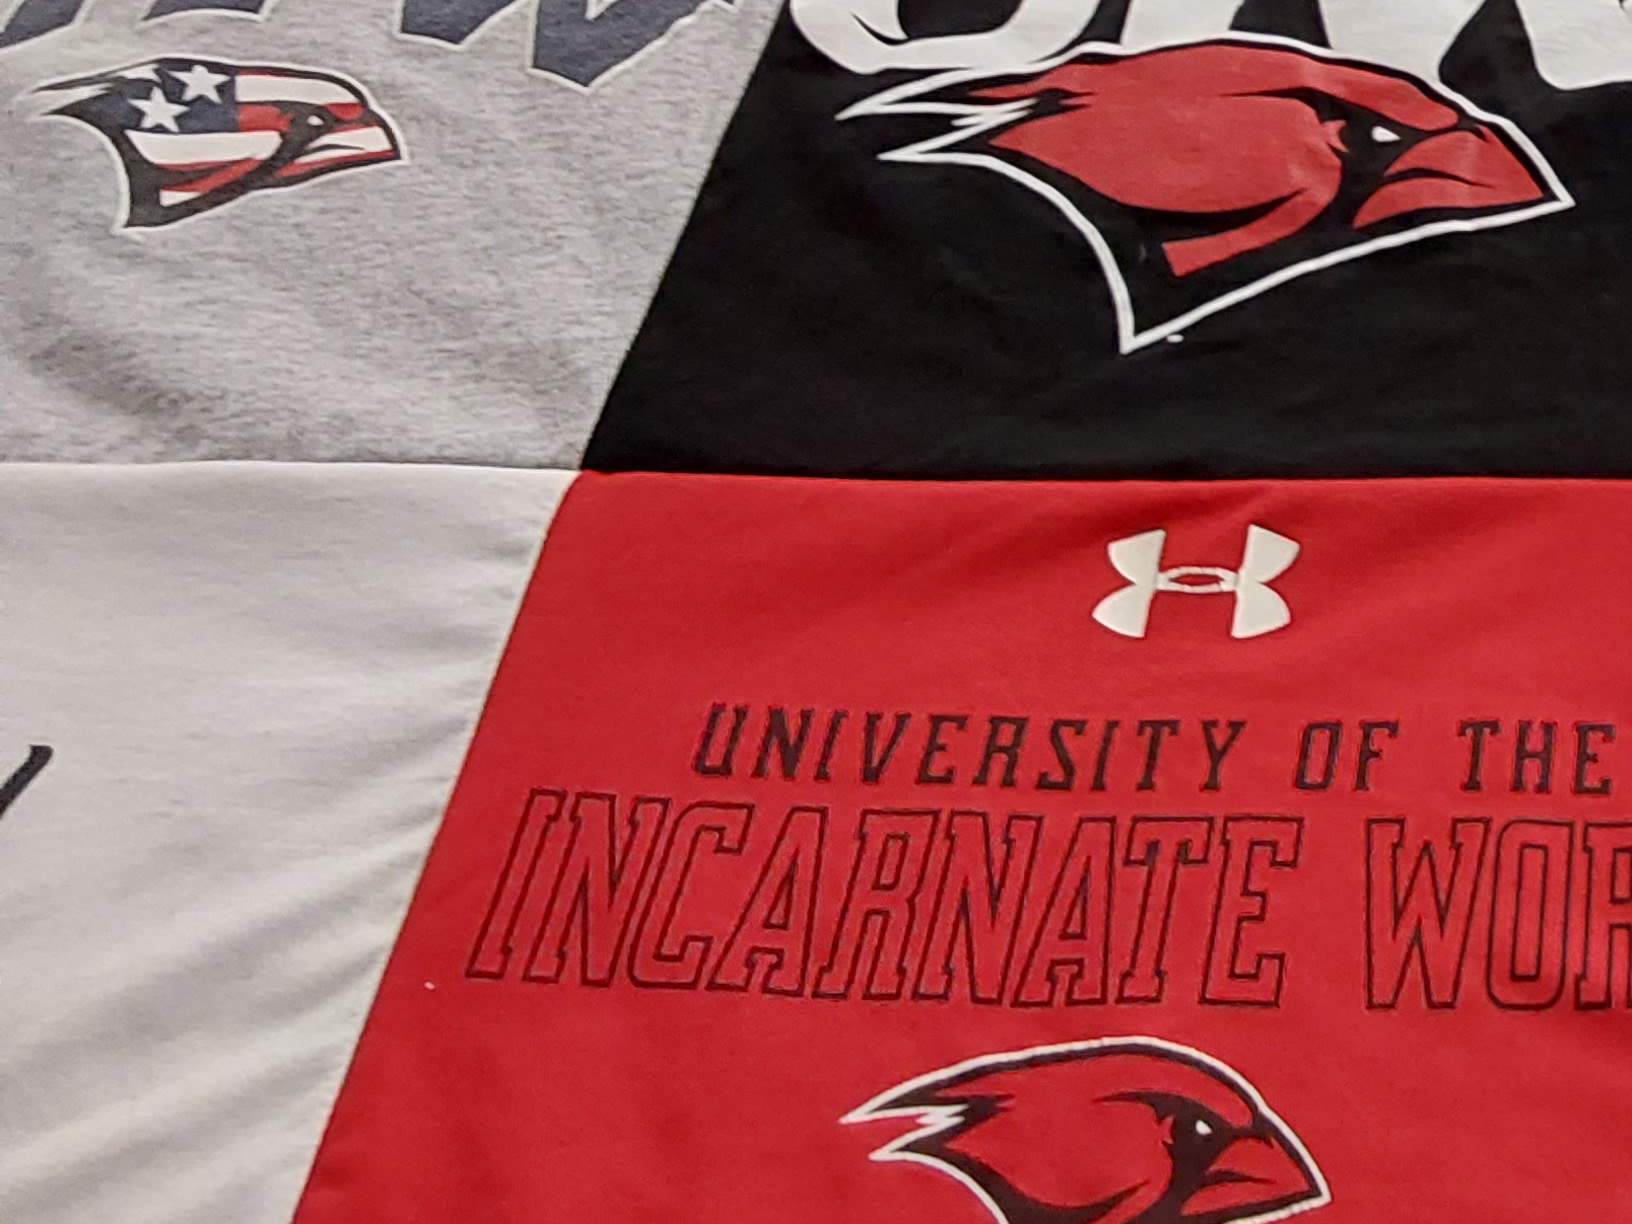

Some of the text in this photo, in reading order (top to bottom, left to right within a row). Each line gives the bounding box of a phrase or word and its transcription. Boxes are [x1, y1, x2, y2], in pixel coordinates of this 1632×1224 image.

[690, 702, 1616, 796] UNIVERSITY OF THE
[466, 788, 1306, 1011] INCARNATE
